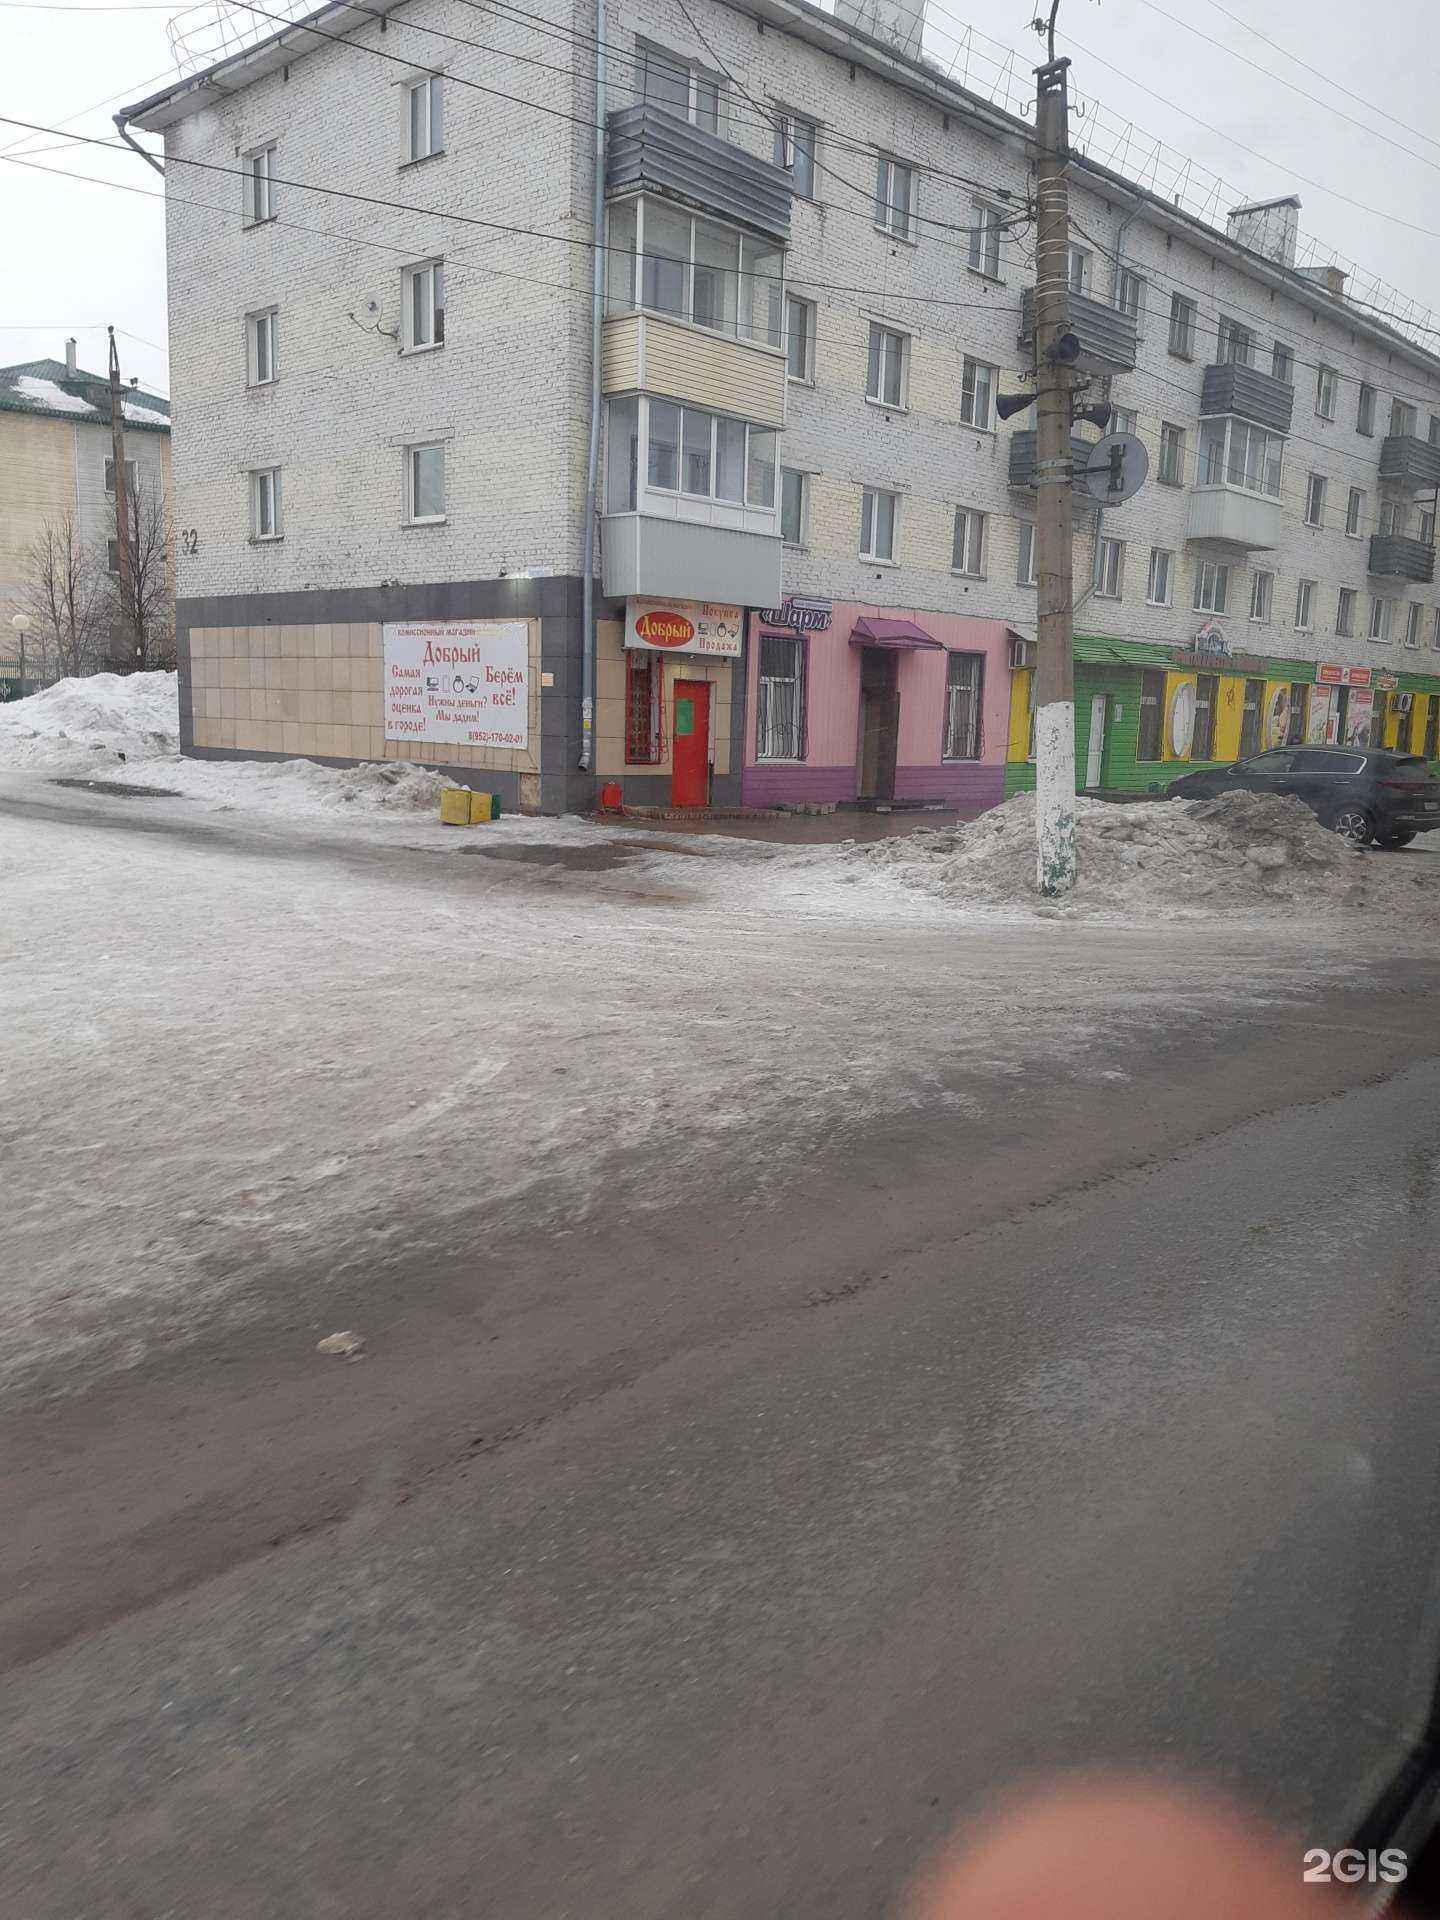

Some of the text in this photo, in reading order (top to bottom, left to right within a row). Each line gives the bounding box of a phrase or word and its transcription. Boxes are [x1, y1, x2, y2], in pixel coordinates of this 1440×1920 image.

[702, 604, 739, 620] Покупка
[639, 615, 692, 641] Добрый
[699, 637, 738, 652] Продажа
[423, 640, 481, 669] Добрый
[391, 664, 421, 678] Самая
[485, 665, 524, 686] Берём
[389, 686, 423, 699] дорогая
[492, 687, 516, 706] всё!
[391, 703, 422, 715] оценка
[428, 695, 487, 710] Нужны деньги?
[435, 709, 480, 723] Мы дадим!
[387, 717, 427, 734] в городе!
